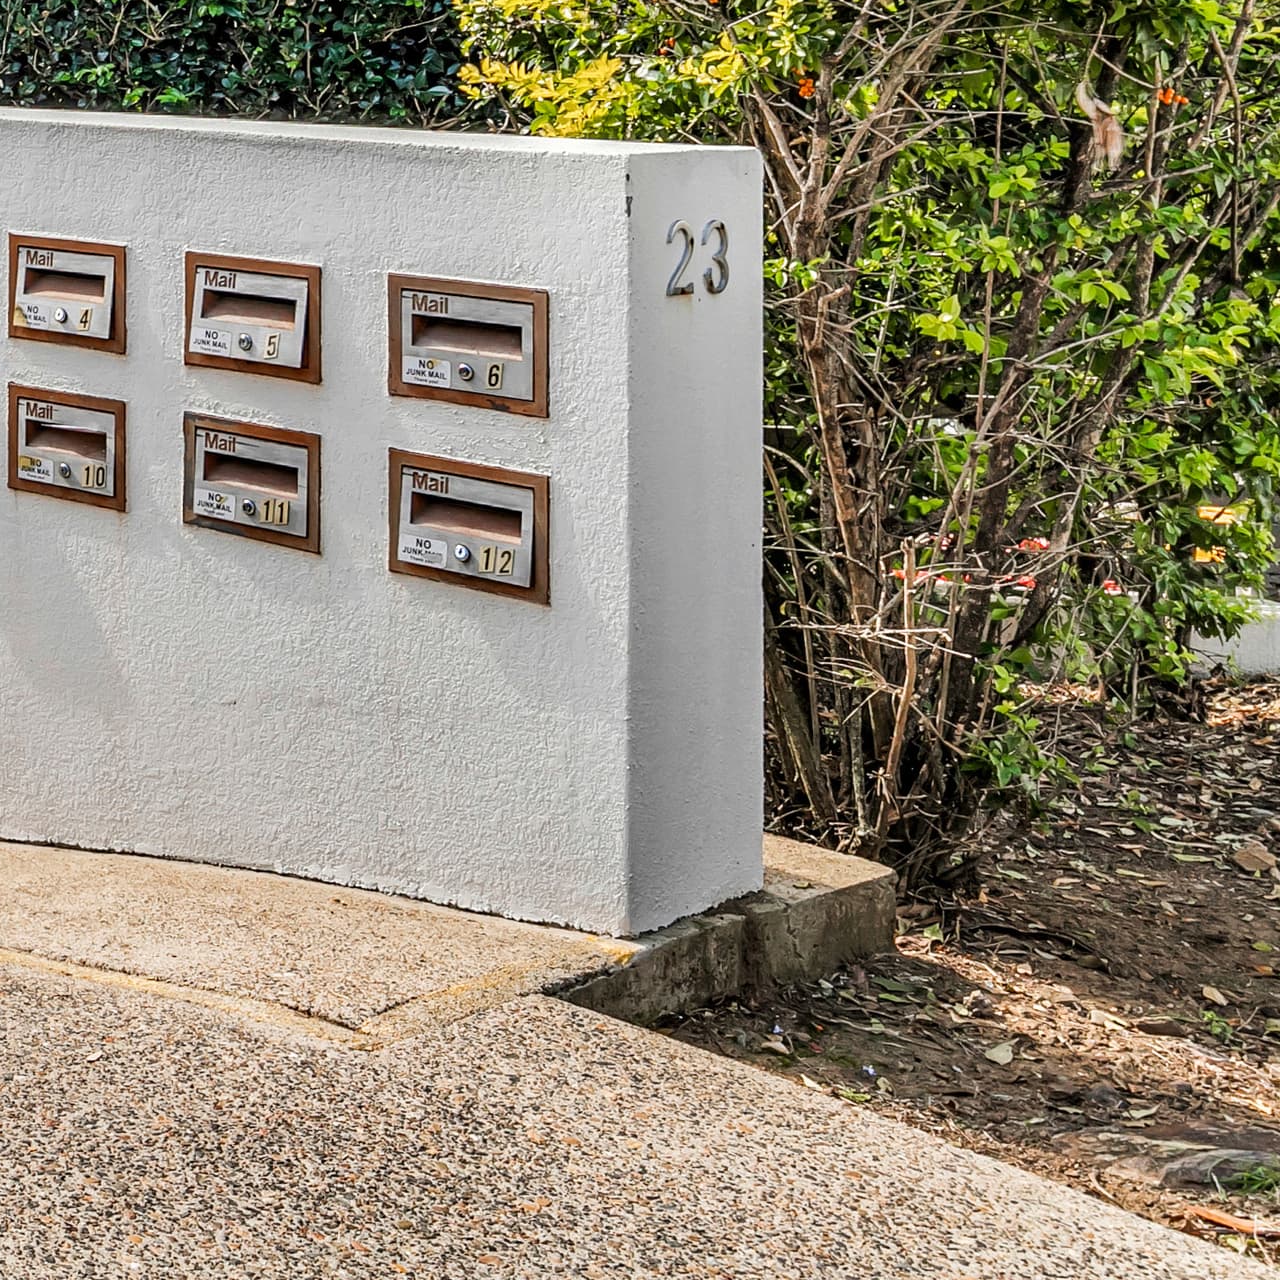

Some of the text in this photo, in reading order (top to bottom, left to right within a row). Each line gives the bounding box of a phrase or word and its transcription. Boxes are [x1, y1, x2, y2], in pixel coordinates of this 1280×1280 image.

[26, 250, 54, 267] Mail
[666, 218, 729, 296] 23
[204, 270, 237, 289] Mail
[27, 305, 39, 314] NO
[412, 294, 449, 314] Mail
[80, 309, 89, 328] 4
[205, 330, 219, 339] NO
[193, 338, 228, 350] JUNK MAIL
[267, 335, 277, 356] 5
[418, 359, 434, 370] NO
[405, 368, 447, 380] JUNK MAIL
[488, 364, 500, 387] 6
[26, 402, 53, 420] Mail
[205, 432, 236, 453] Mail
[30, 458, 42, 467] NO
[84, 465, 105, 487] 10
[412, 472, 449, 494] Mail
[208, 492, 221, 502] NO
[197, 500, 232, 513] JUNK MAIL
[263, 500, 284, 523] 11
[402, 546, 423, 556] JUNK
[415, 538, 432, 549] NO
[483, 548, 512, 573] 12
